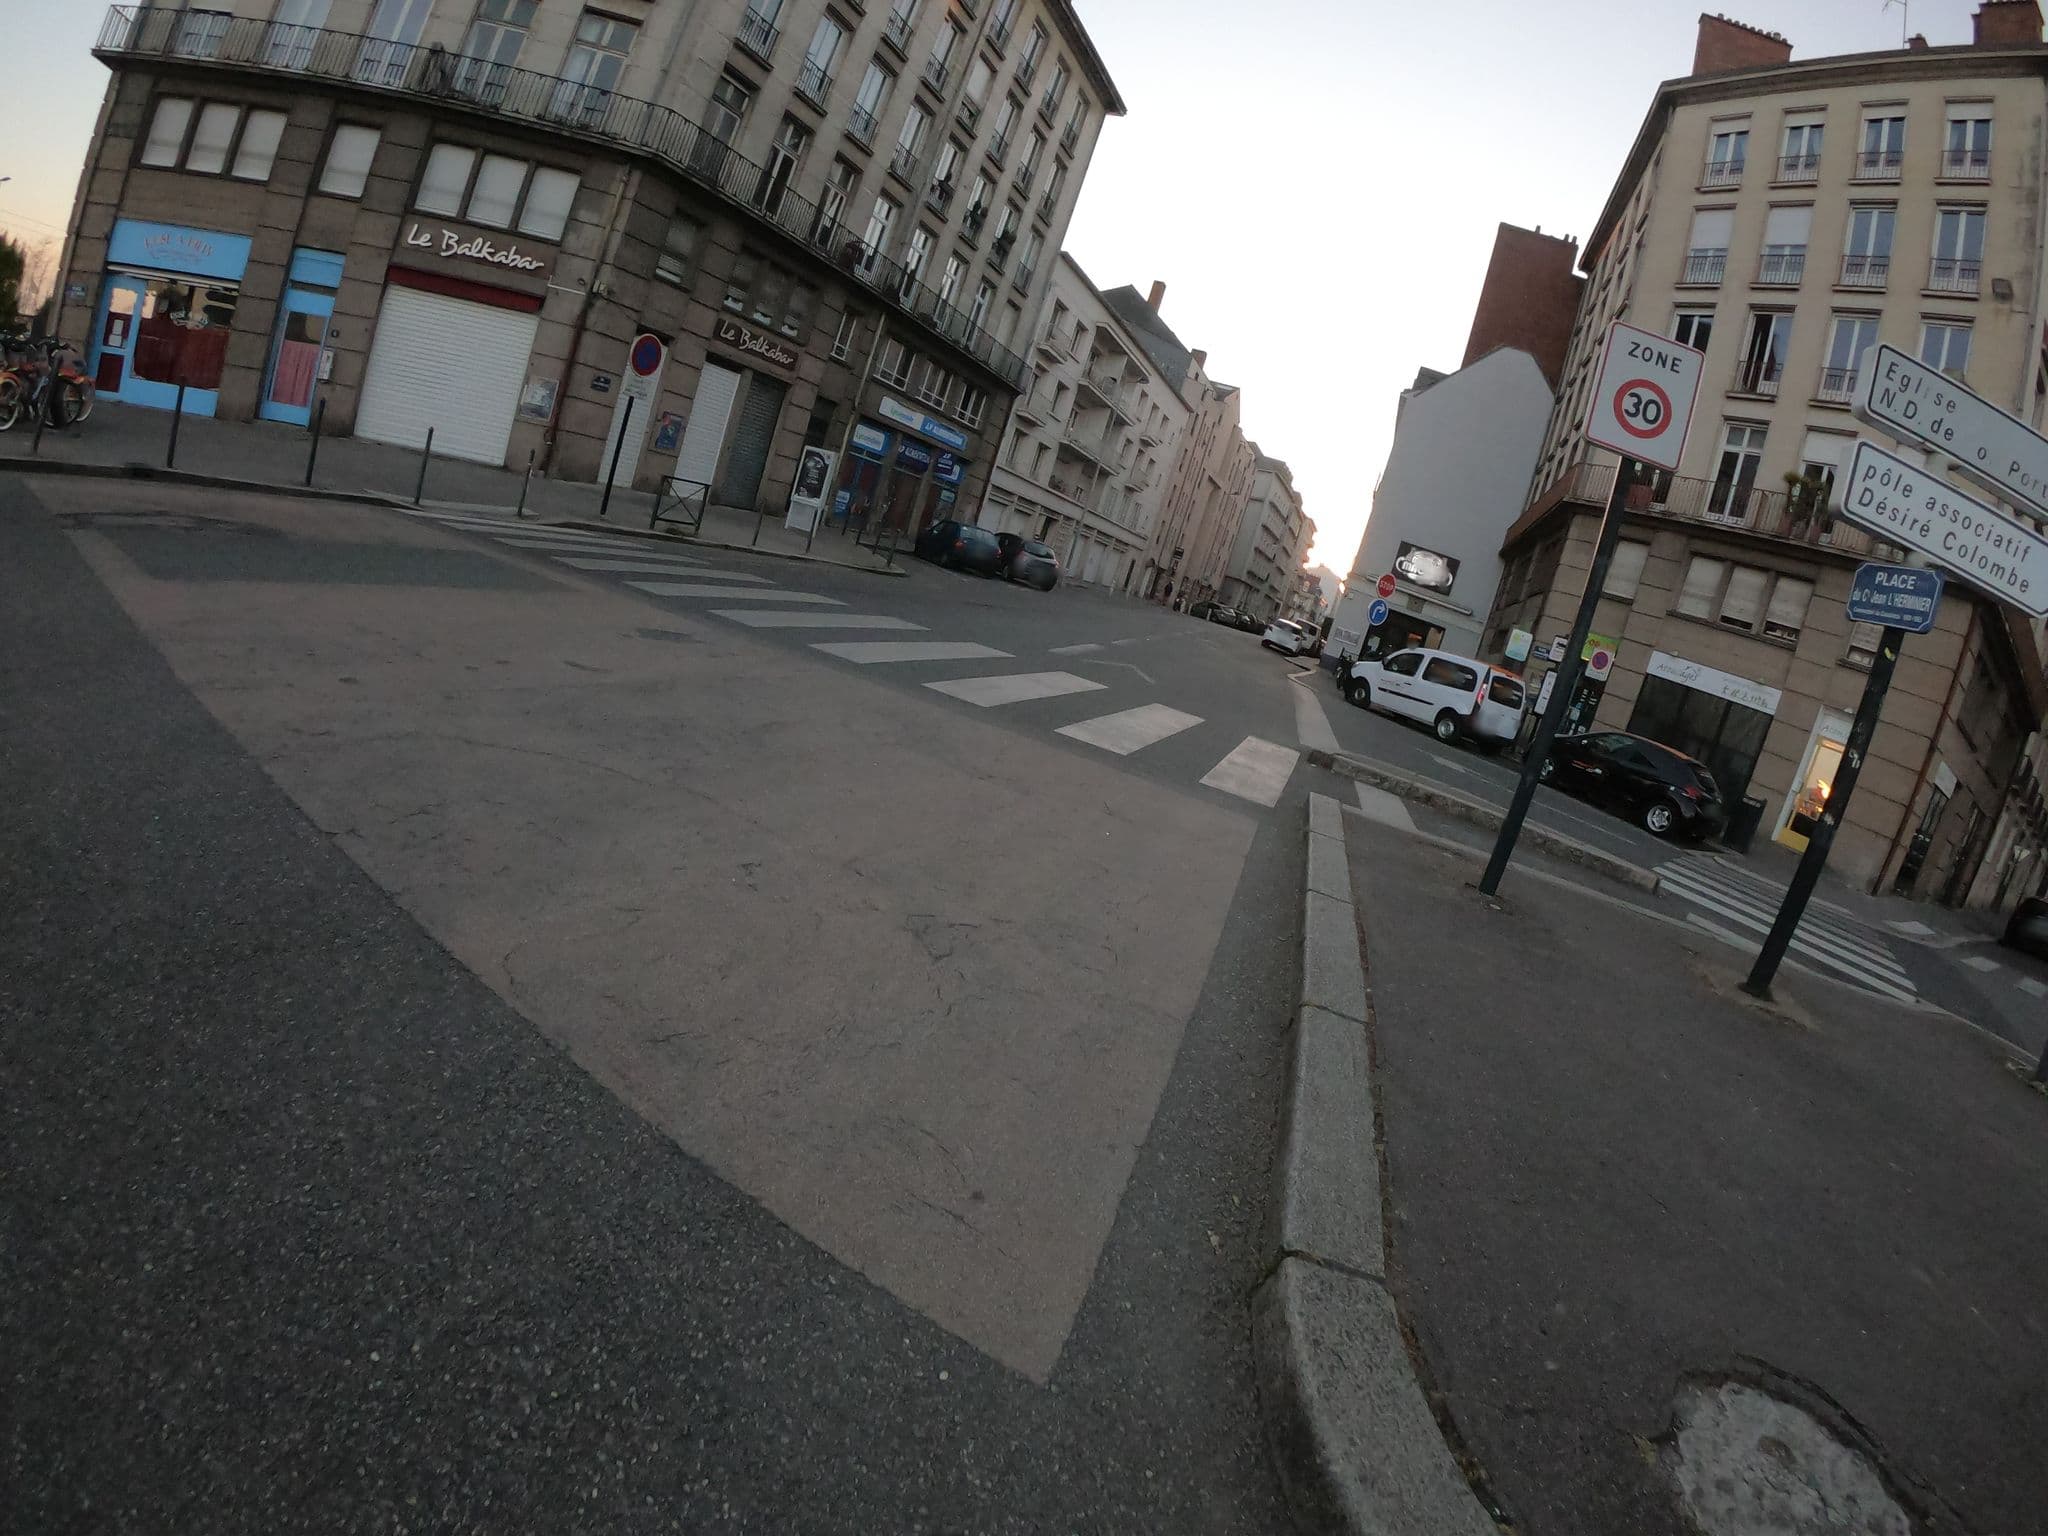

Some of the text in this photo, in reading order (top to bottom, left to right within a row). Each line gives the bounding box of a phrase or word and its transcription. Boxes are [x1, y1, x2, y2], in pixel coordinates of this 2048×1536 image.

[407, 223, 545, 270] Le Balkabar
[720, 320, 794, 364] Le Balkabar
[1628, 341, 1682, 374] ZONE
[1623, 392, 1661, 425] 30
[1930, 417, 1954, 442] de
[1862, 463, 2032, 563] pôle associatif
[1857, 486, 2030, 594] Désiré Colombe
[1871, 590, 1887, 604] Jean
[1875, 571, 1917, 590] PLACE
